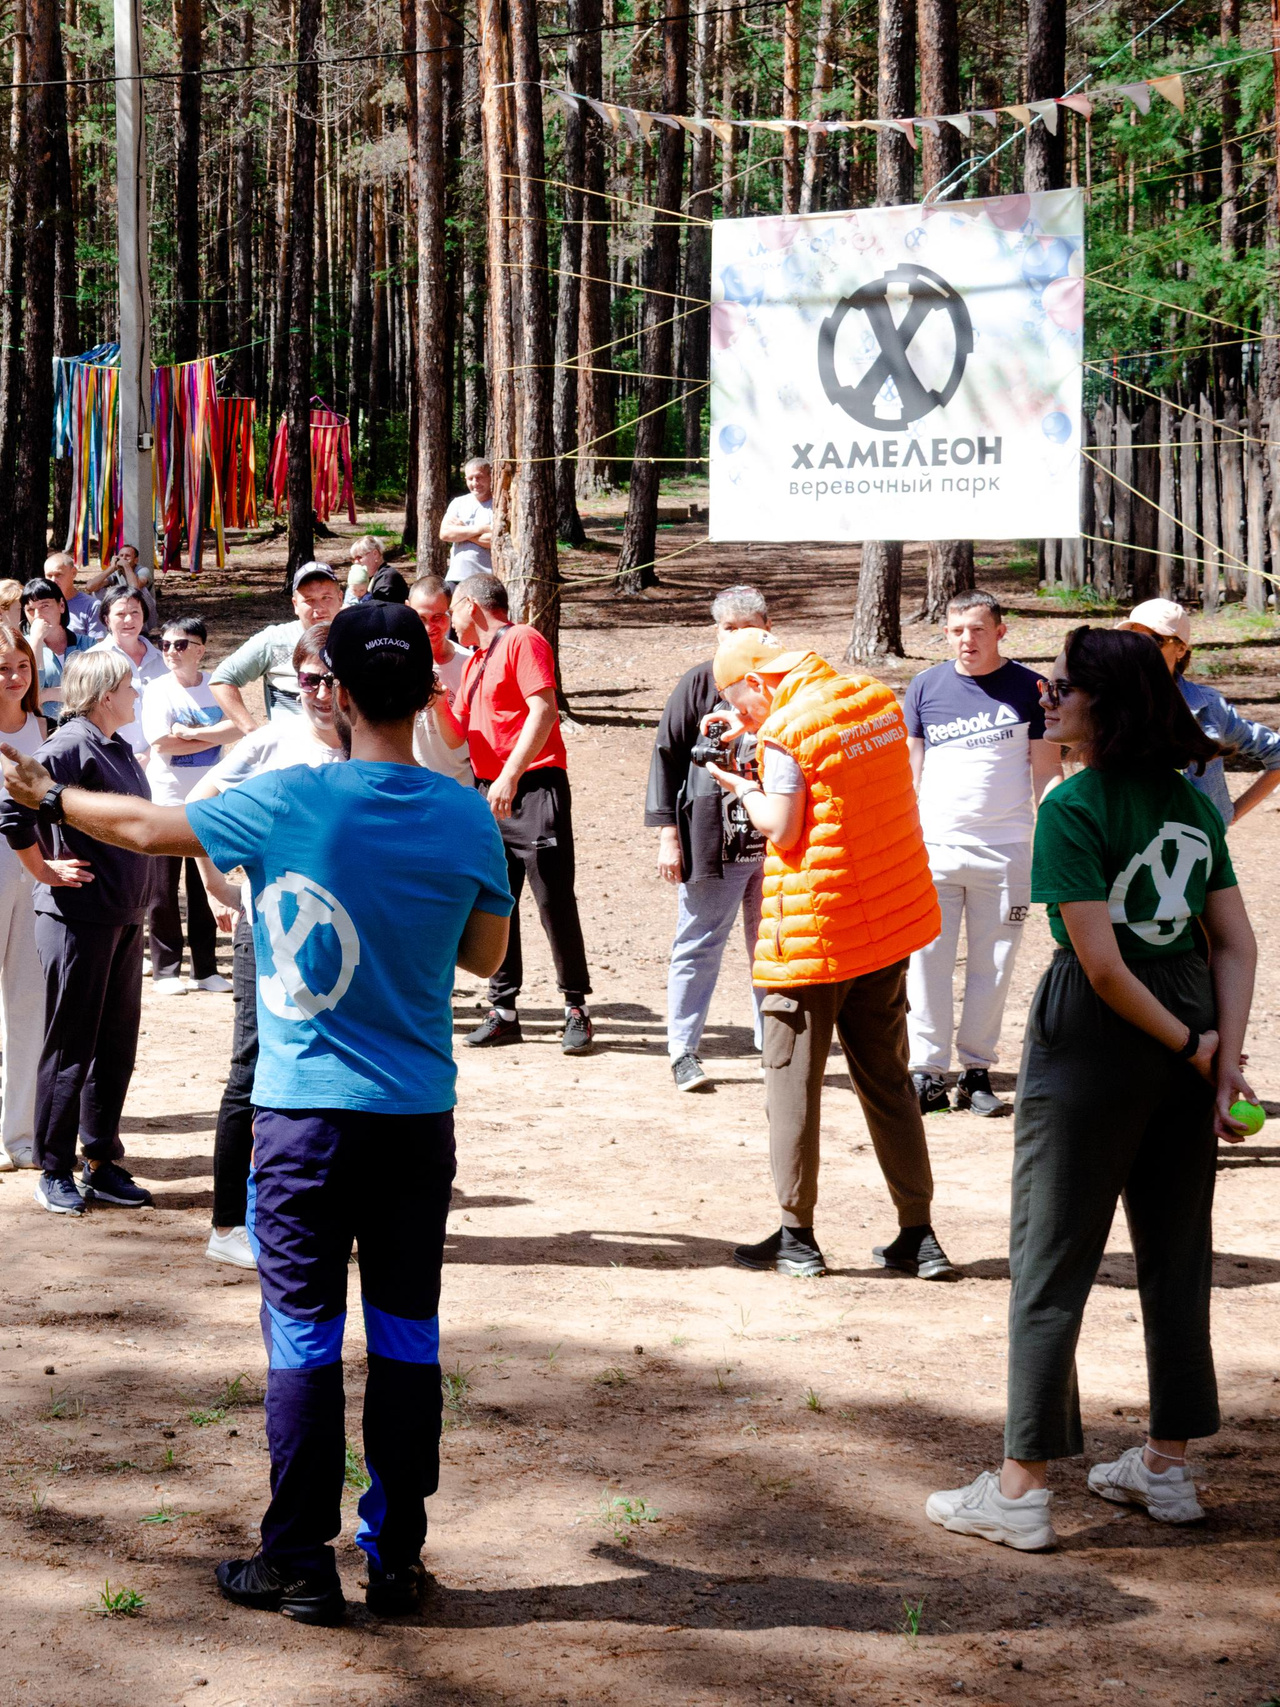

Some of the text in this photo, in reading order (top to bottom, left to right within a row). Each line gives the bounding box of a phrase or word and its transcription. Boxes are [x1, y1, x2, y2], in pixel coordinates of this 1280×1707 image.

[790, 436, 1003, 470] ХАМЕЛЕОН
[789, 472, 1001, 502] веревочный парк
[364, 637, 411, 651] МИХТАХОВ
[838, 711, 899, 746] ДРУГАЯ ЖИЗНЬ
[844, 742, 865, 760] LIFE
[870, 725, 905, 749] TRAVELS
[926, 711, 994, 745] Reebok
